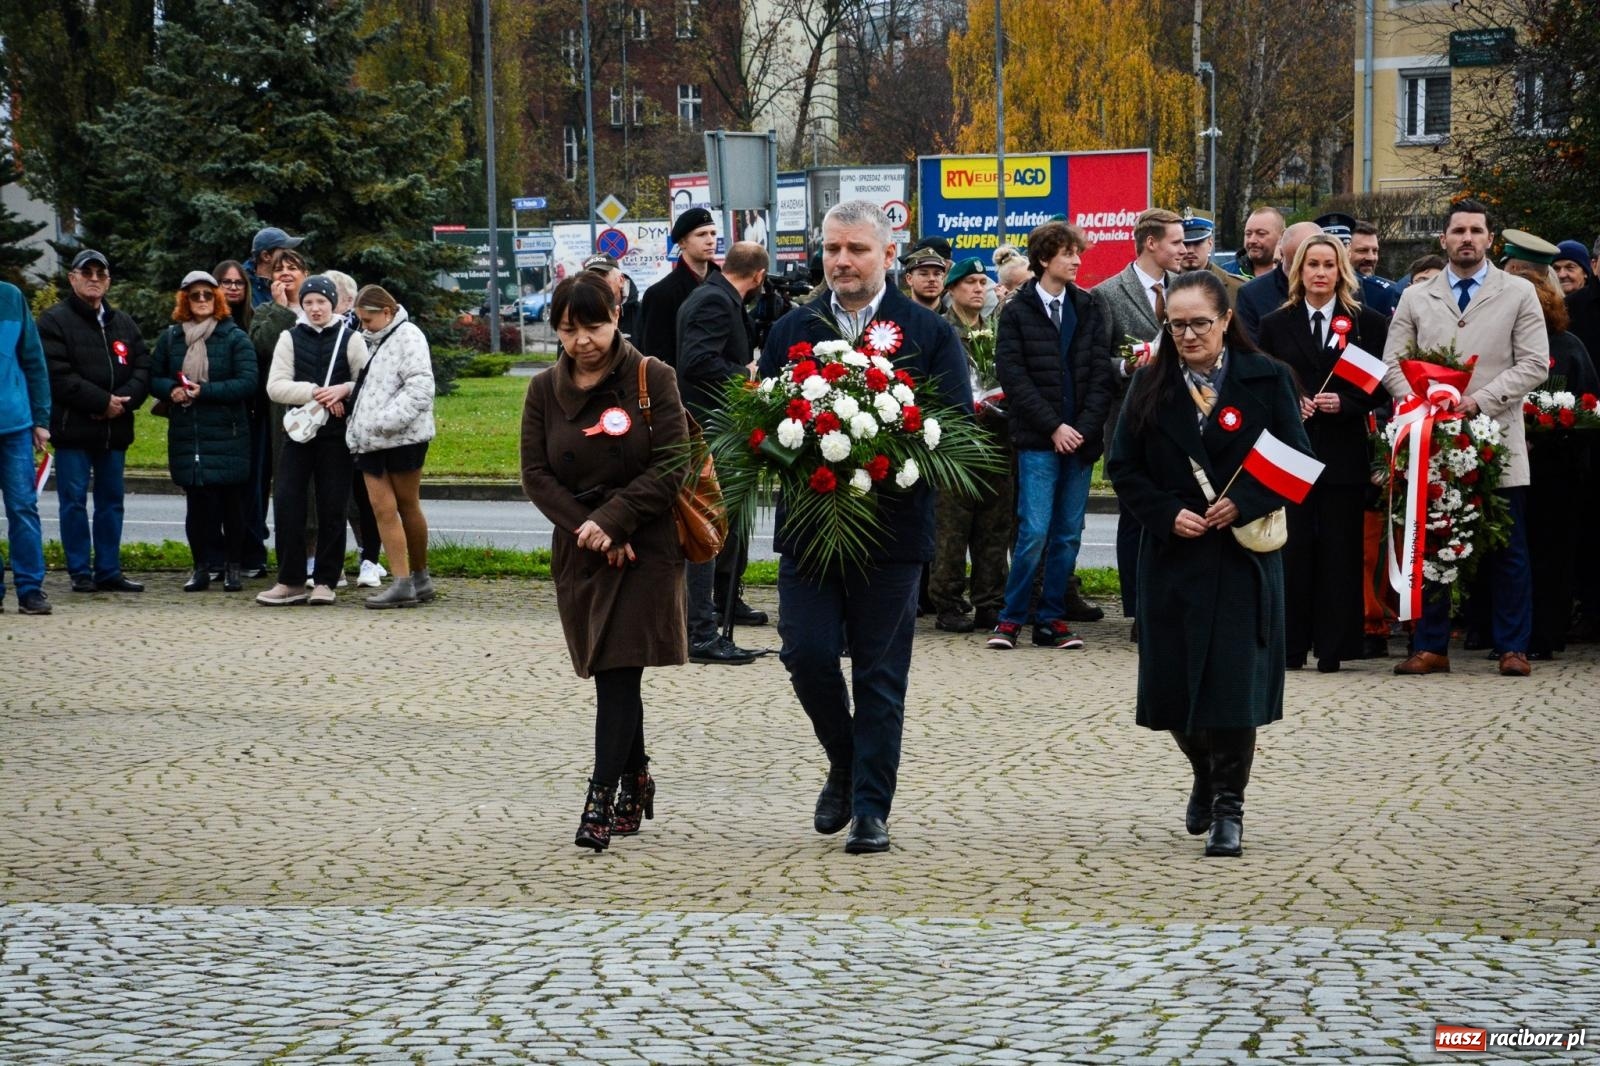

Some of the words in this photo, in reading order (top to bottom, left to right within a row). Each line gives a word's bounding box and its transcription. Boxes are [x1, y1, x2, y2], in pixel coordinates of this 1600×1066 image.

[946, 170, 974, 187] RTV
[1013, 168, 1046, 186] AGD
[855, 184, 891, 193] NIERUCHOMOŚCI
[887, 207, 896, 222] 4
[898, 214, 903, 222] t
[938, 212, 982, 232] Tysiące
[984, 211, 1054, 231] prduktów
[1088, 229, 1130, 244] Rybnicka
